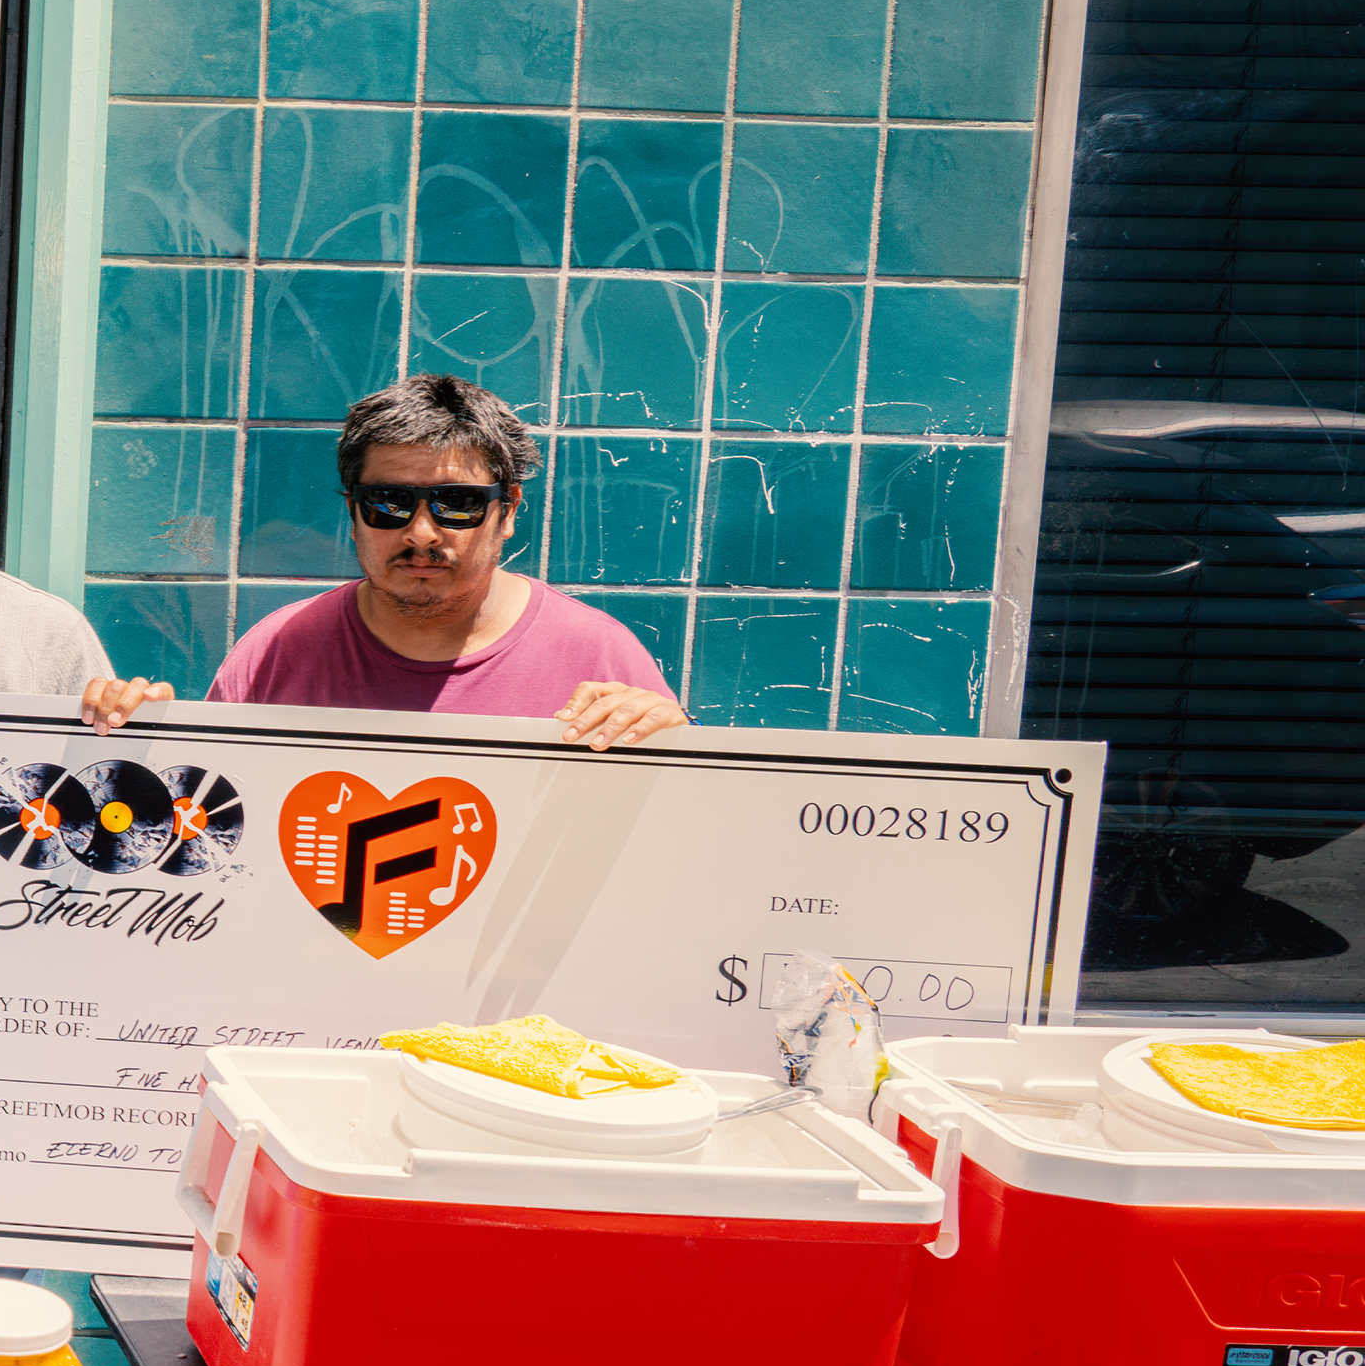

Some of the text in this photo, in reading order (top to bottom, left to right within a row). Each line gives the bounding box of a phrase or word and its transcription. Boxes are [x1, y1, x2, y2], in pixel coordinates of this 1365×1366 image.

[799, 801, 1010, 845] 00028189
[769, 895, 839, 916] DATE:
[128, 890, 225, 947] Mob
[715, 955, 748, 1007] $
[19, 998, 49, 1014] TO
[55, 1000, 99, 1018] THE
[55, 1021, 90, 1038] OF:
[117, 1067, 168, 1088] FIVE
[113, 1107, 198, 1127] RECOR
[149, 1148, 183, 1164] TO
